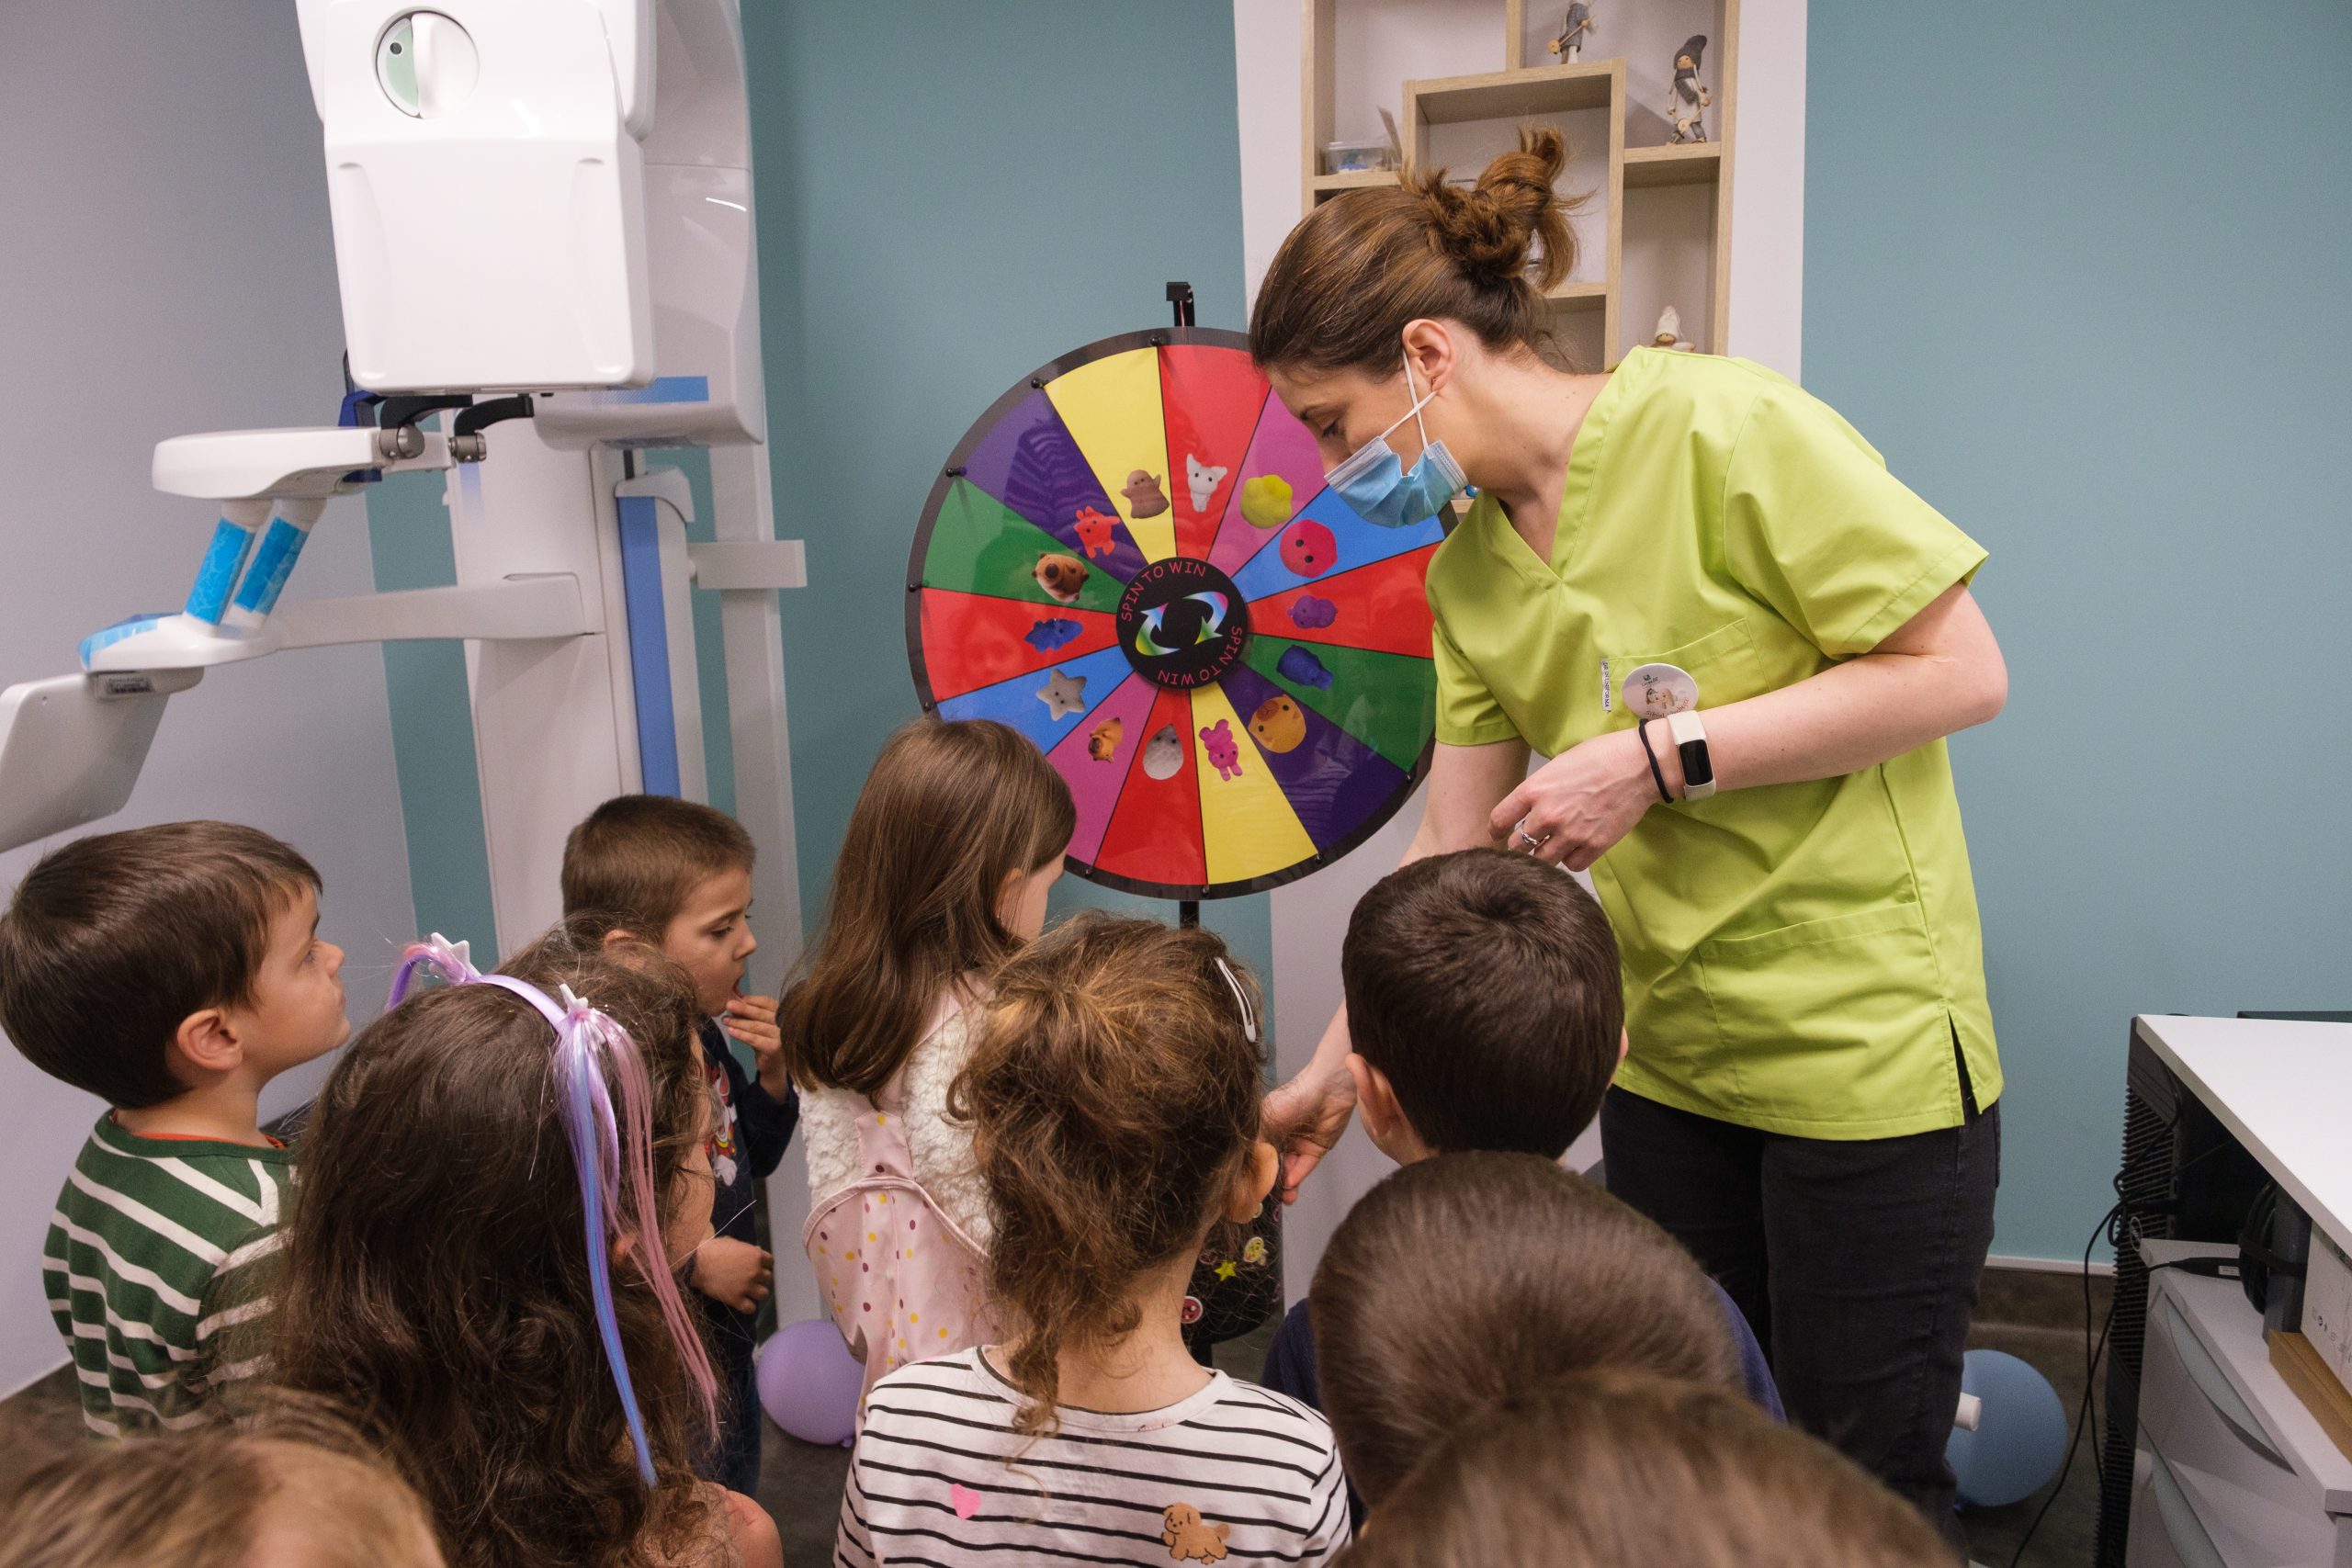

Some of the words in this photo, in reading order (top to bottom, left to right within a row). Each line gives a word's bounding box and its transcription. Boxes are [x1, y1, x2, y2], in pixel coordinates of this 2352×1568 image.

[1121, 581, 1145, 622] SPIN
[1142, 565, 1164, 582] TO
[1169, 560, 1206, 578] WIN
[1219, 626, 1242, 665] SPIN
[1158, 670, 1194, 686] WIN
[1199, 666, 1221, 682] TO
